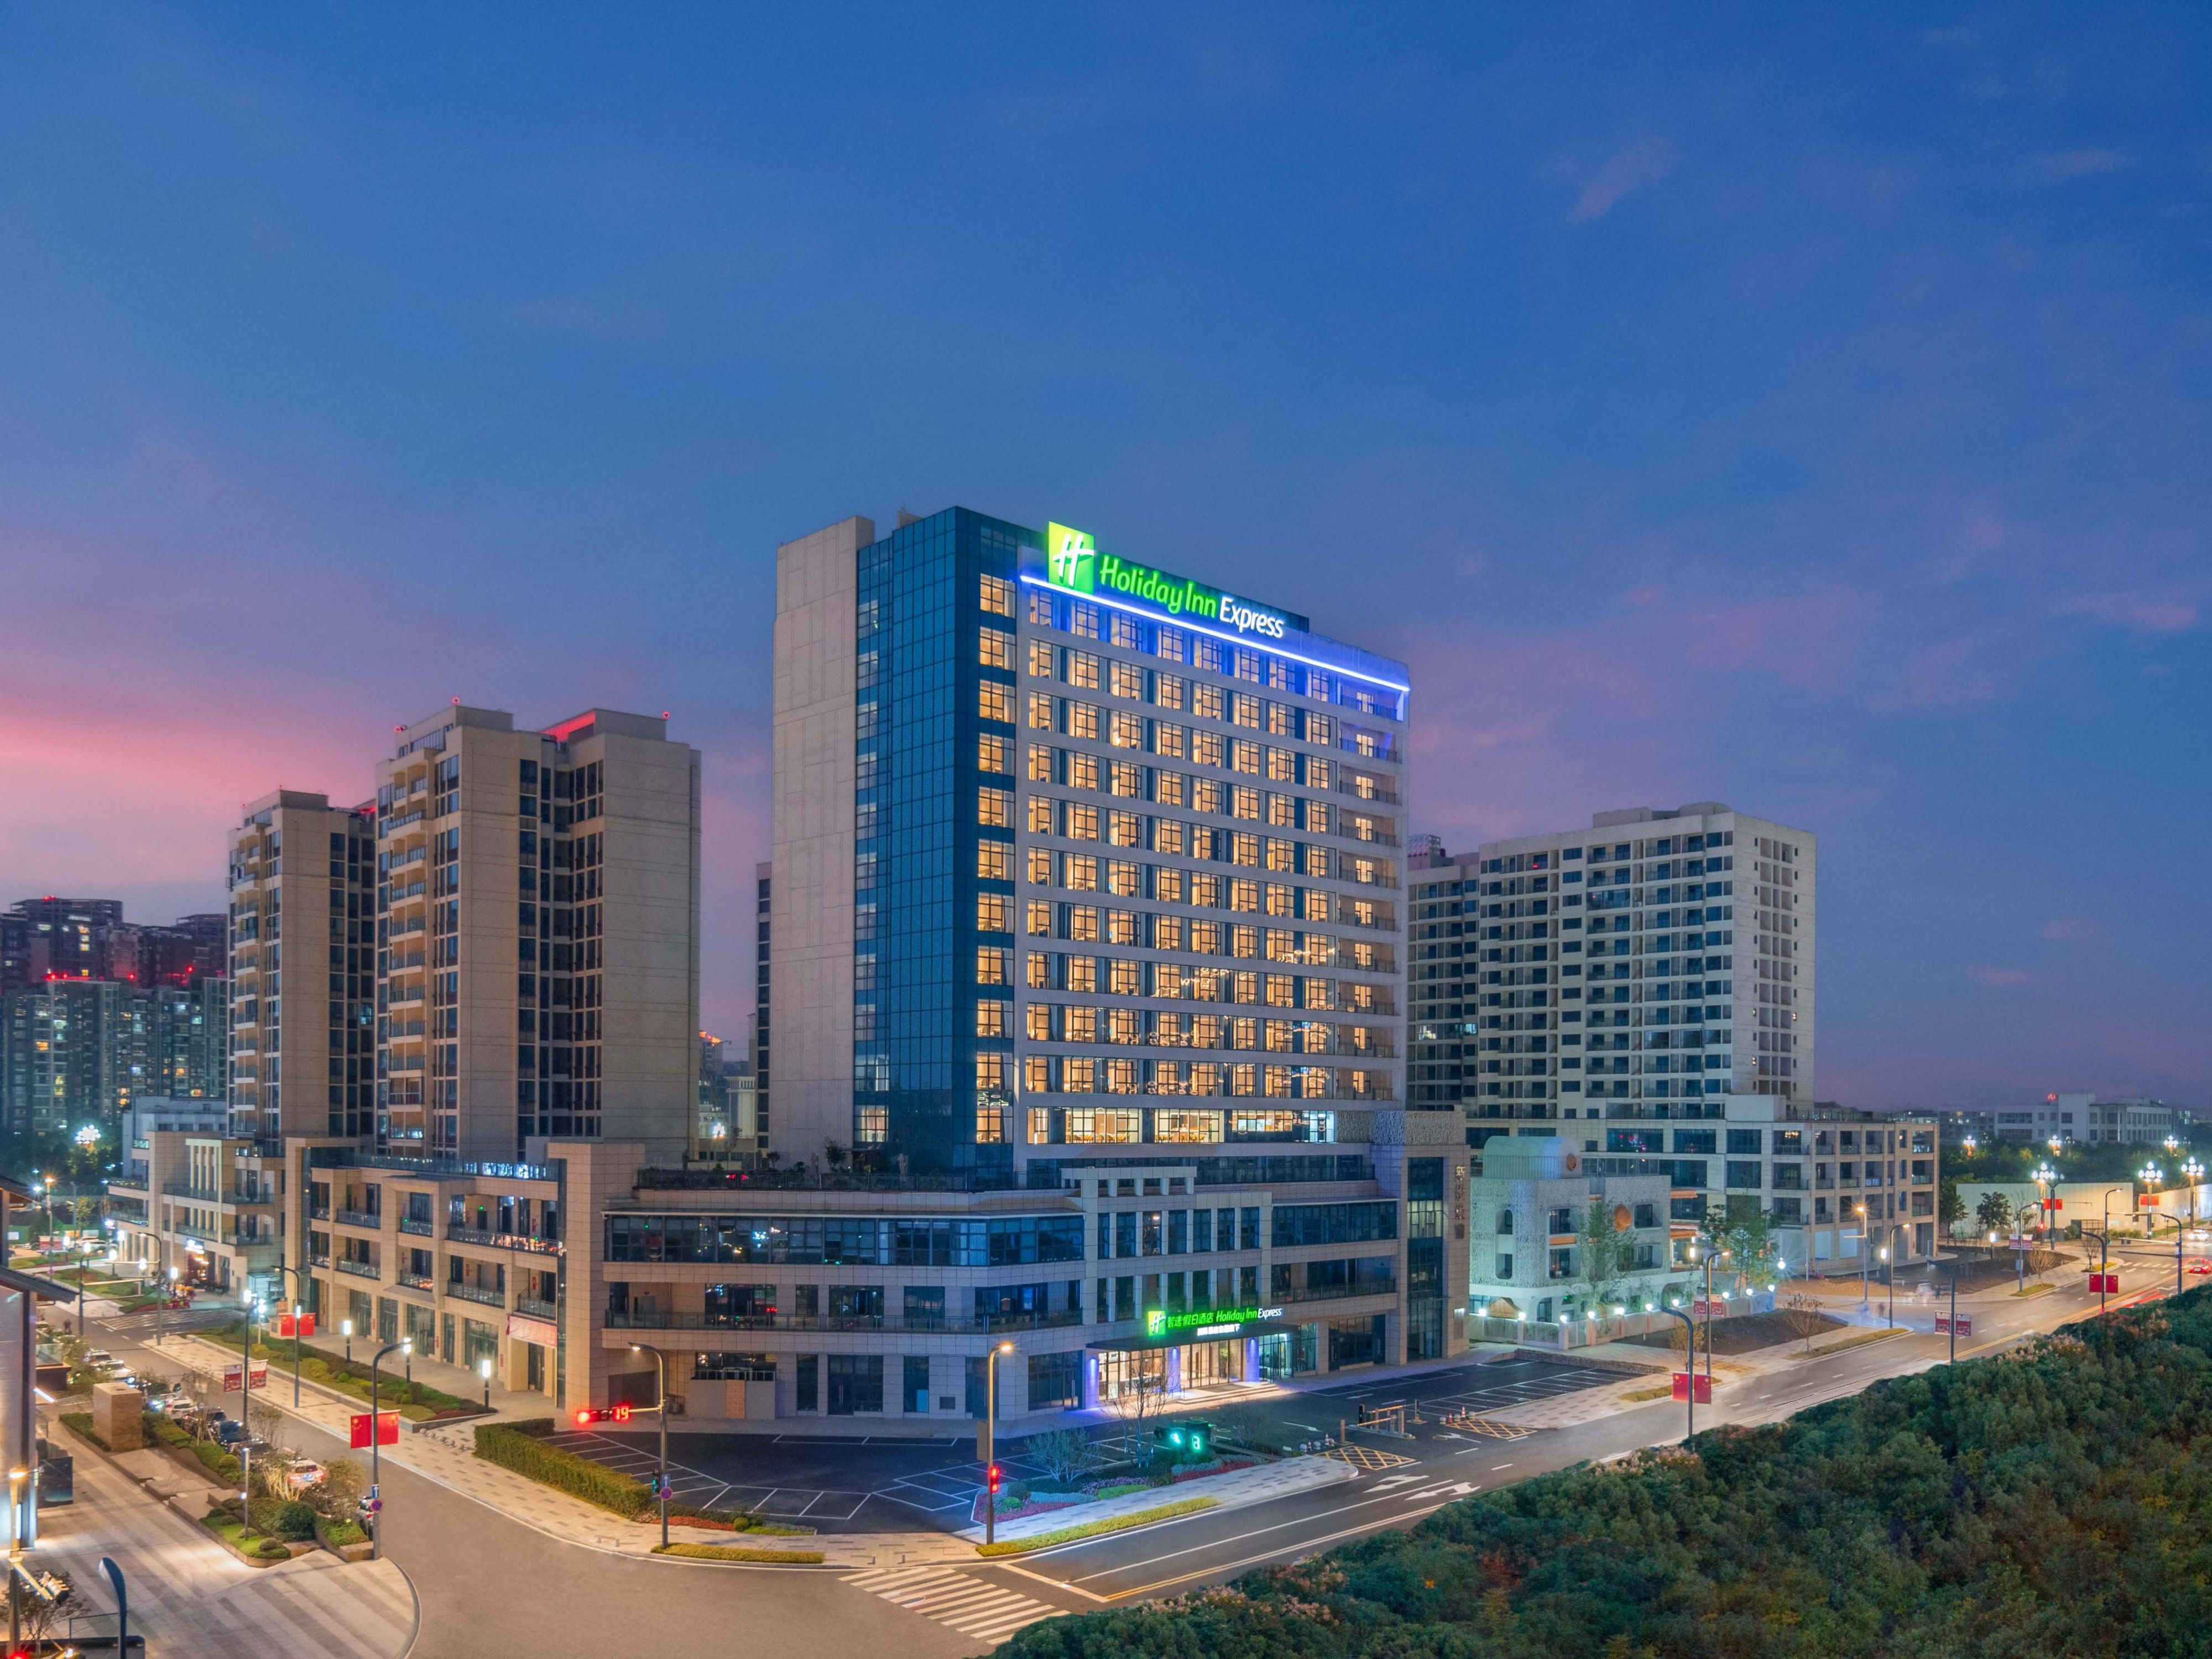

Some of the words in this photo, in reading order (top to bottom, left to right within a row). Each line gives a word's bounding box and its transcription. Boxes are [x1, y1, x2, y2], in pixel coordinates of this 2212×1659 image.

[1100, 555, 1182, 614] Holiday
[1186, 581, 1217, 618] Inn
[1220, 597, 1284, 638] Express
[1167, 1312, 1213, 1327] 智选假日酒店
[1217, 1309, 1244, 1323] Holiday
[1246, 1308, 1258, 1318] Inn
[1258, 1308, 1282, 1319] Express
[616, 1407, 629, 1420] 19
